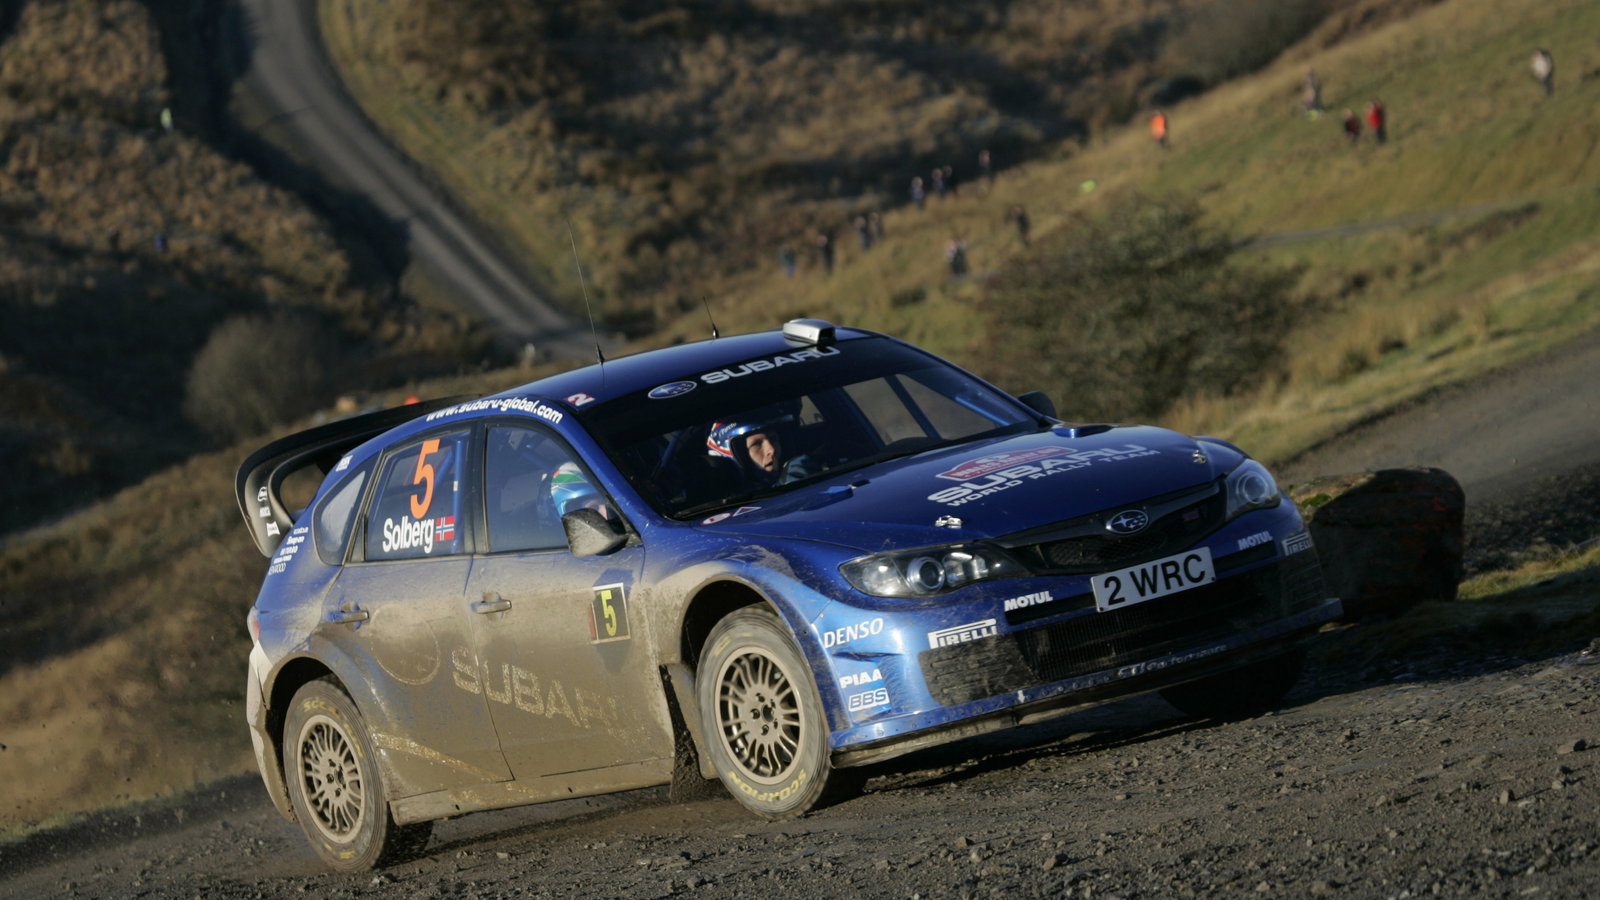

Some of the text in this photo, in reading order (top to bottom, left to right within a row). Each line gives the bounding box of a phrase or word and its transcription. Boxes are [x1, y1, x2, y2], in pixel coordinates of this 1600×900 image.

[700, 346, 841, 384] SUBARU
[425, 395, 563, 424] www.subaru-global.com
[410, 438, 440, 520] 5
[927, 443, 1148, 503] SUBARU
[946, 479, 1024, 507] WORLD
[1028, 460, 1092, 479] RALLY
[1098, 449, 1161, 462] TEAM
[382, 515, 435, 554] Solberg
[1237, 530, 1274, 551] MOTUL
[1103, 553, 1206, 606] 2 WRC
[600, 589, 618, 637] 5
[1004, 590, 1054, 612] MOTUL
[823, 617, 885, 649] DENSO
[927, 617, 998, 650] PIRELLI
[839, 668, 883, 690] PIAA
[849, 687, 890, 712] BBS
